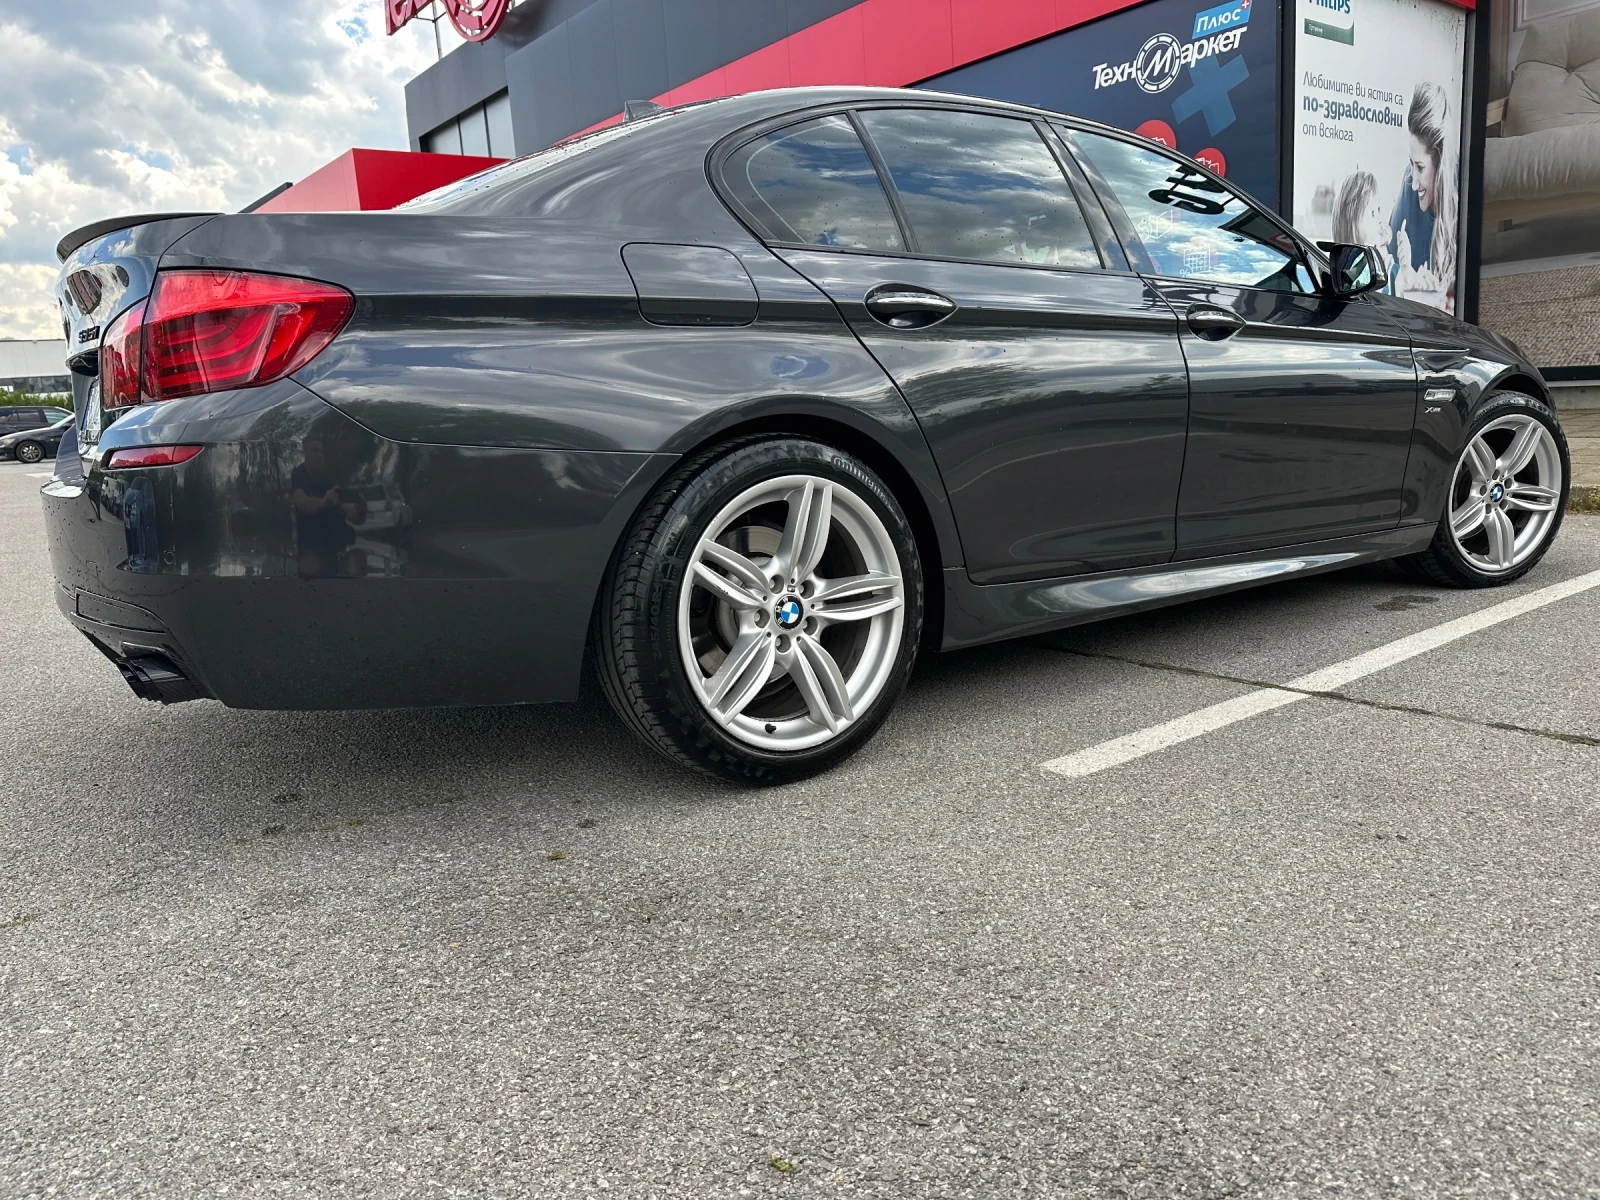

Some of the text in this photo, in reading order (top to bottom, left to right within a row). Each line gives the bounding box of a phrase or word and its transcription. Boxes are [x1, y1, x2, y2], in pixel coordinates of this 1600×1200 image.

[1308, 0, 1351, 14] ILIPS
[1196, 8, 1241, 33] Плюс
[1303, 71, 1404, 106] Любимите ви ястия са
[1303, 95, 1403, 128] по-здравословни
[1302, 122, 1354, 142] от всякога
